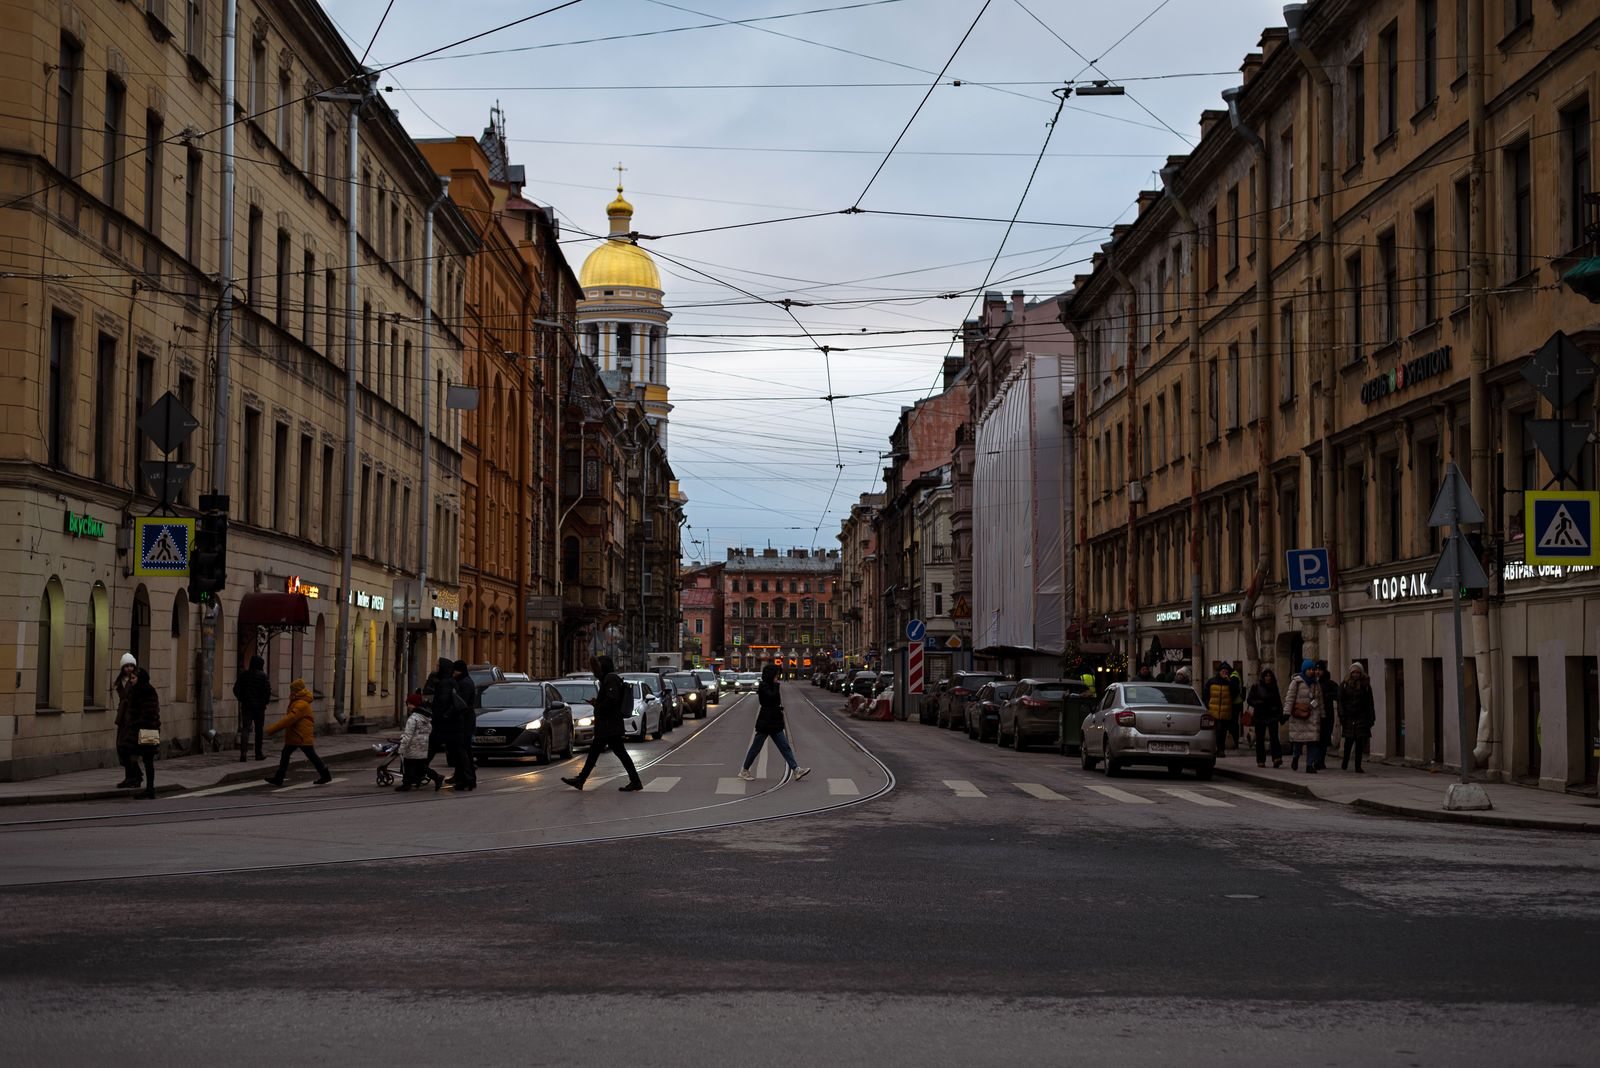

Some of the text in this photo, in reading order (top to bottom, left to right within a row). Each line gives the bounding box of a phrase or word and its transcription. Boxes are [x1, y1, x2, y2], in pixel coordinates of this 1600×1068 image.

[1405, 347, 1452, 387] STATION
[1361, 375, 1388, 404] ОТЕЛЬ
[1503, 561, 1534, 581] АВТРАК
[1373, 572, 1438, 601] тарелк
